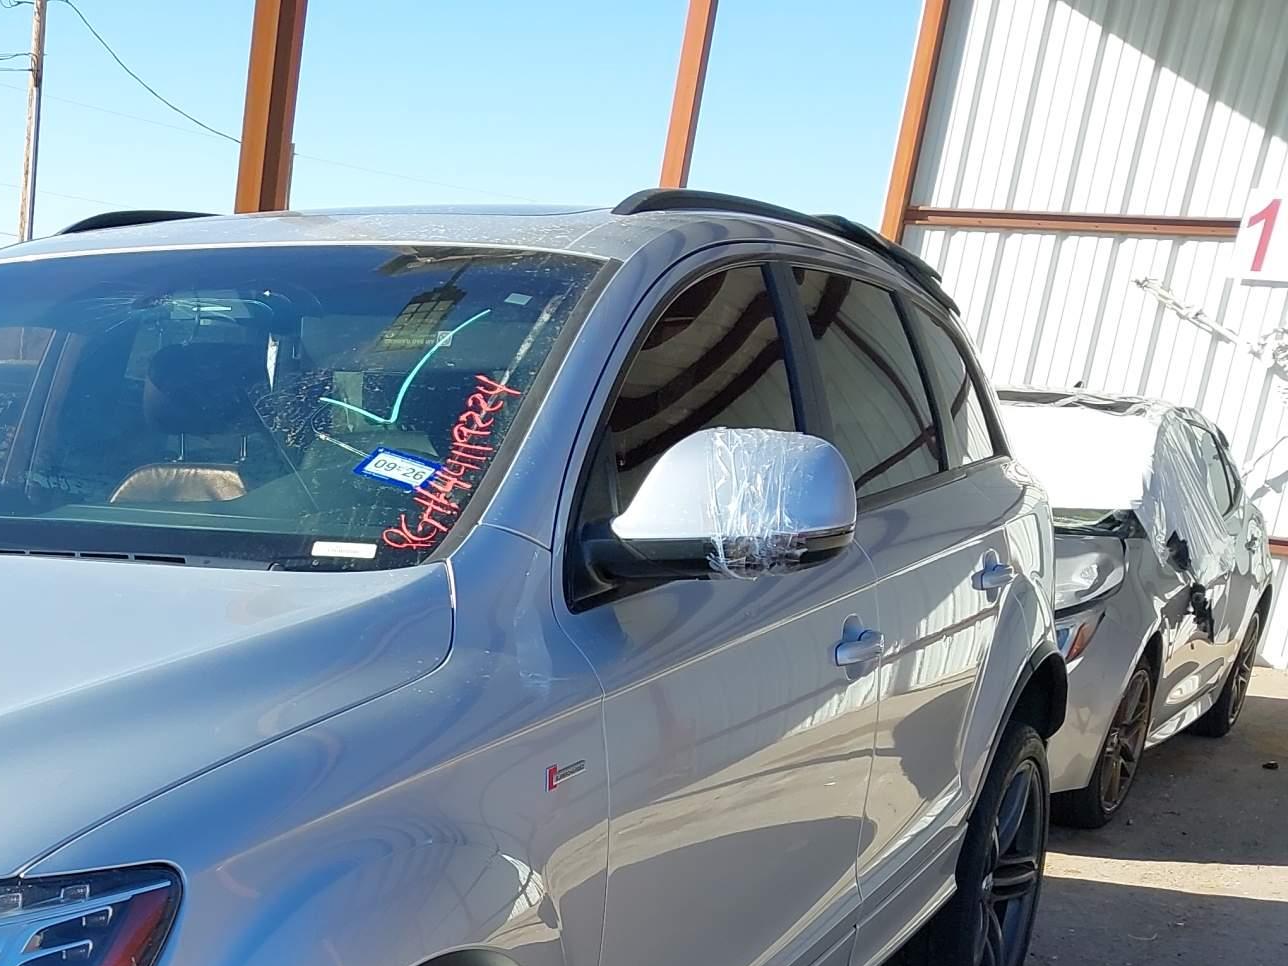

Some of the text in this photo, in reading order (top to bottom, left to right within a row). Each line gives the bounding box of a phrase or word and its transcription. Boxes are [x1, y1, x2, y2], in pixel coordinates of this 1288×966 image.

[1247, 199, 1282, 272] 1
[374, 458, 426, 481] 09 26
